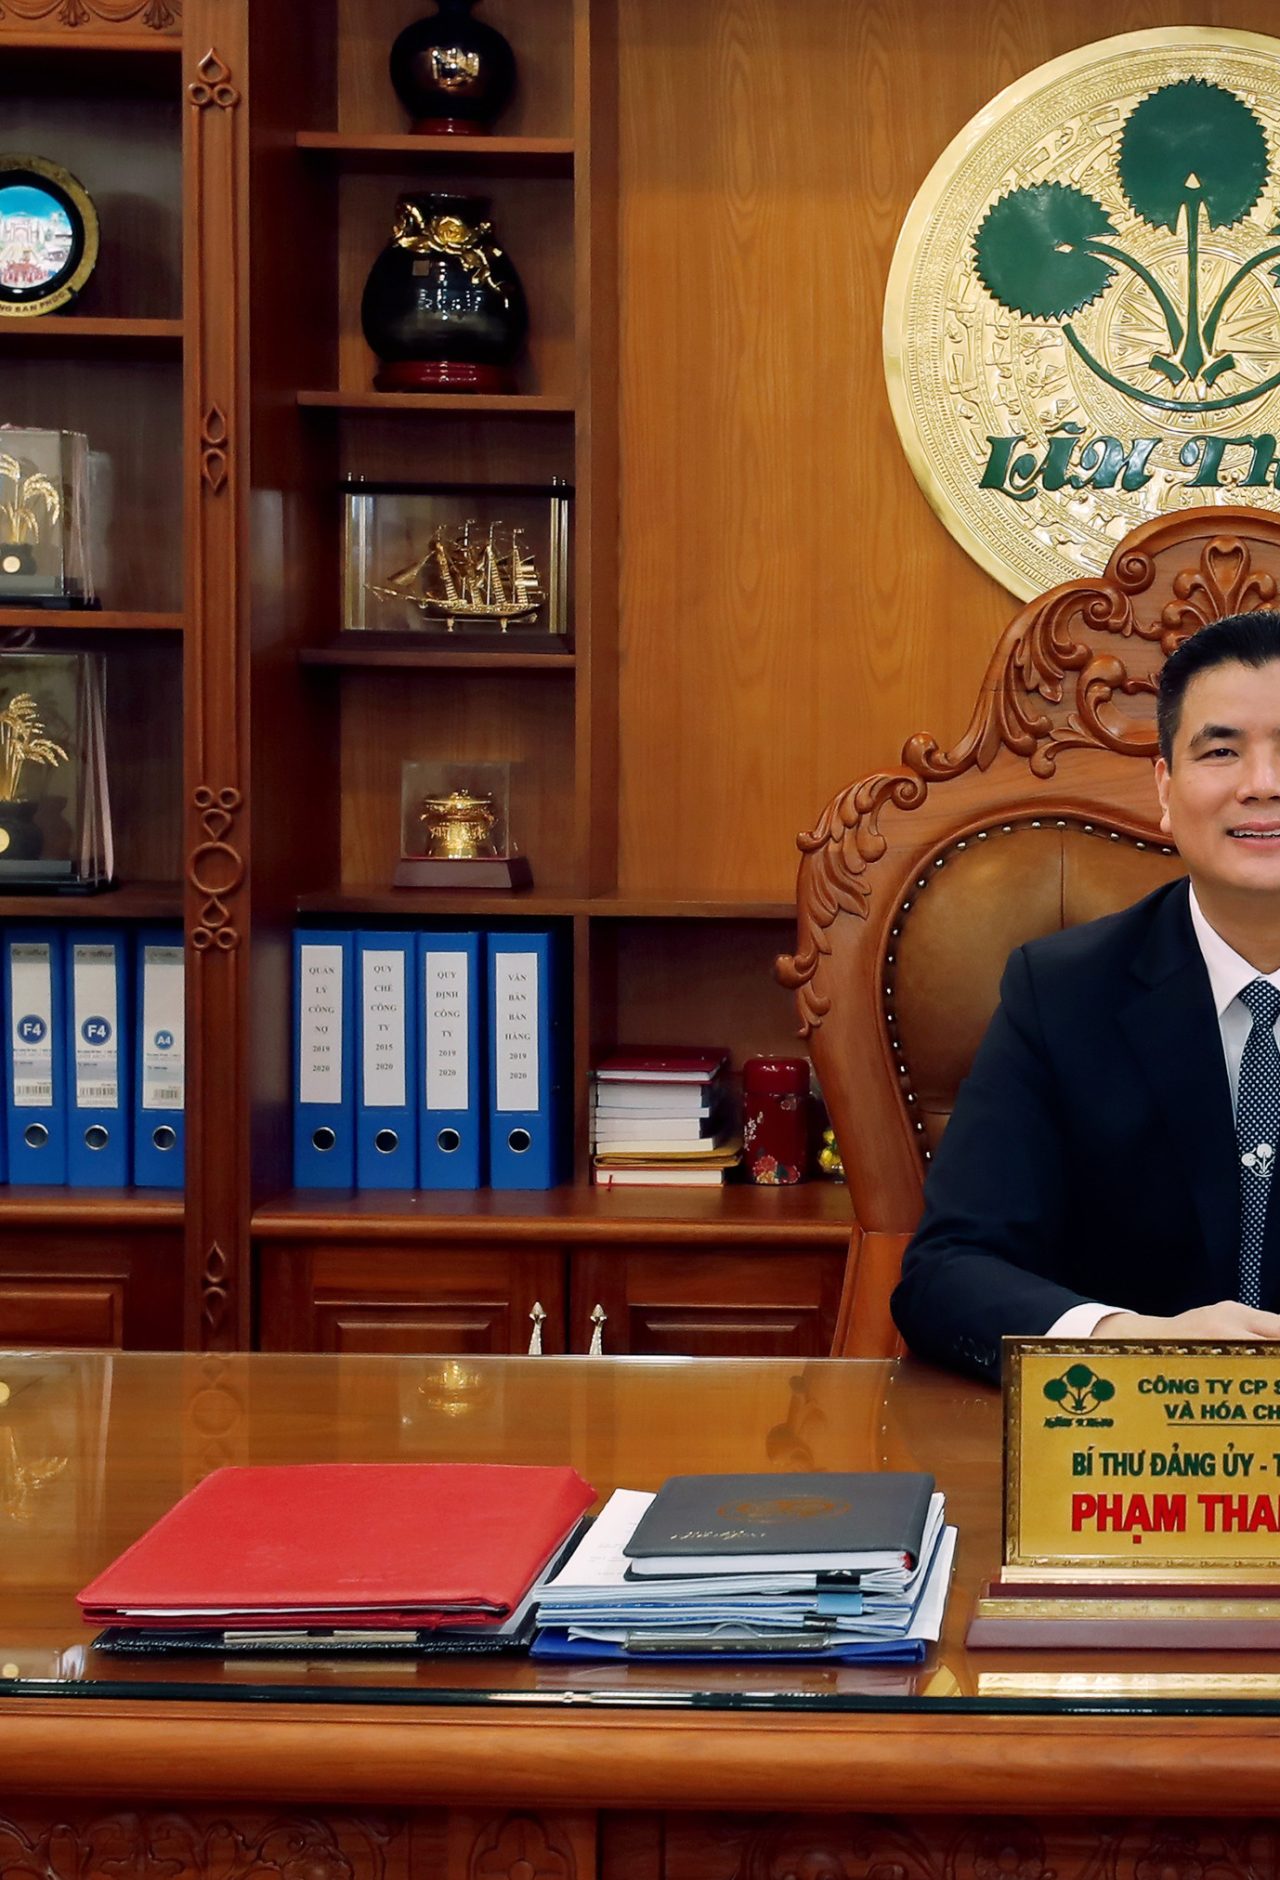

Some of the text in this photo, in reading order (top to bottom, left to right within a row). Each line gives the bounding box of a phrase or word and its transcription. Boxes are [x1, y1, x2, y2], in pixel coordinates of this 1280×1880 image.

[978, 421, 1163, 500] LÂM
[308, 1004, 335, 1013] CÔNG
[370, 1003, 397, 1011] CÔNG
[434, 1009, 460, 1018] CÔNG
[23, 1022, 42, 1036] F4
[87, 1024, 107, 1038] F4
[378, 1024, 389, 1032] TY
[157, 1035, 171, 1044] A4
[1138, 1375, 1199, 1394] CÔNG
[1206, 1379, 1233, 1394] TY
[1239, 1379, 1268, 1395] CP
[1164, 1401, 1195, 1419] VÀ
[1201, 1401, 1246, 1419] HÓA
[1072, 1446, 1095, 1476] BÍ
[1099, 1449, 1146, 1476] THƯ
[1149, 1442, 1216, 1477] ĐẢNG
[1222, 1442, 1254, 1477] ỦY
[1071, 1493, 1186, 1544] PHẠM
